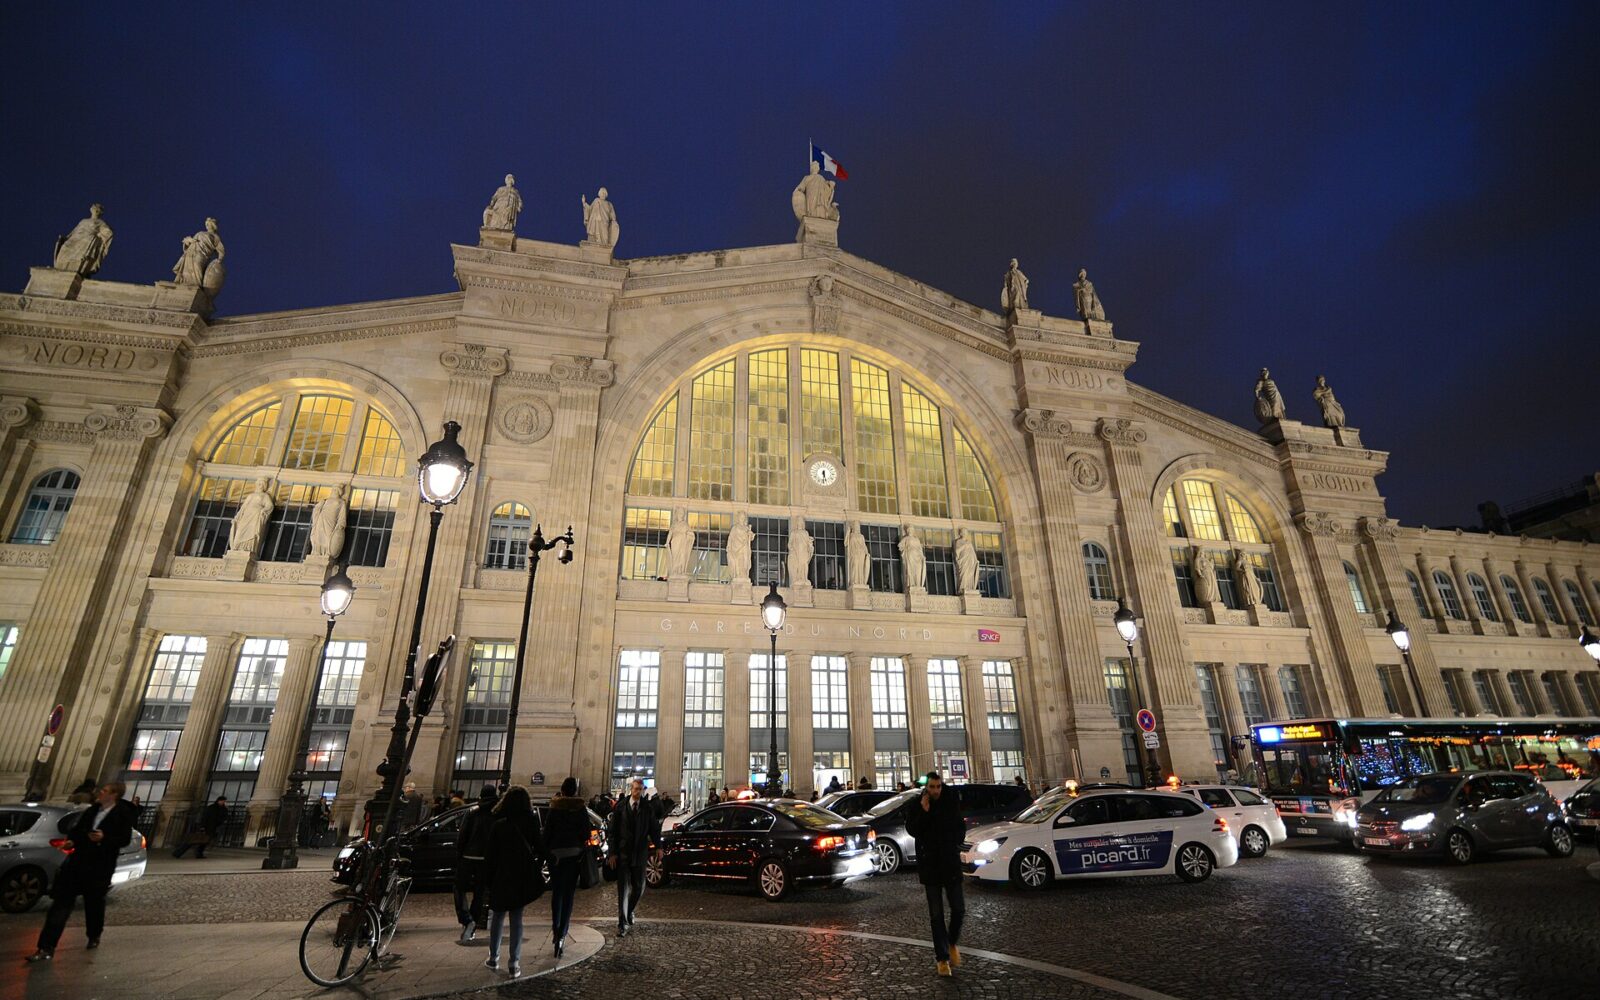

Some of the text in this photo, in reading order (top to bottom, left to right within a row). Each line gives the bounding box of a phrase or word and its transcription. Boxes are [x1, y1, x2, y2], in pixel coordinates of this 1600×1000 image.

[33, 341, 136, 370] NORD
[1311, 472, 1361, 492] NORD
[660, 618, 932, 641] GARE DU NORD
[980, 633, 1000, 641] SNCF
[1068, 841, 1082, 849] Mes
[1081, 845, 1151, 868] picard.fr
